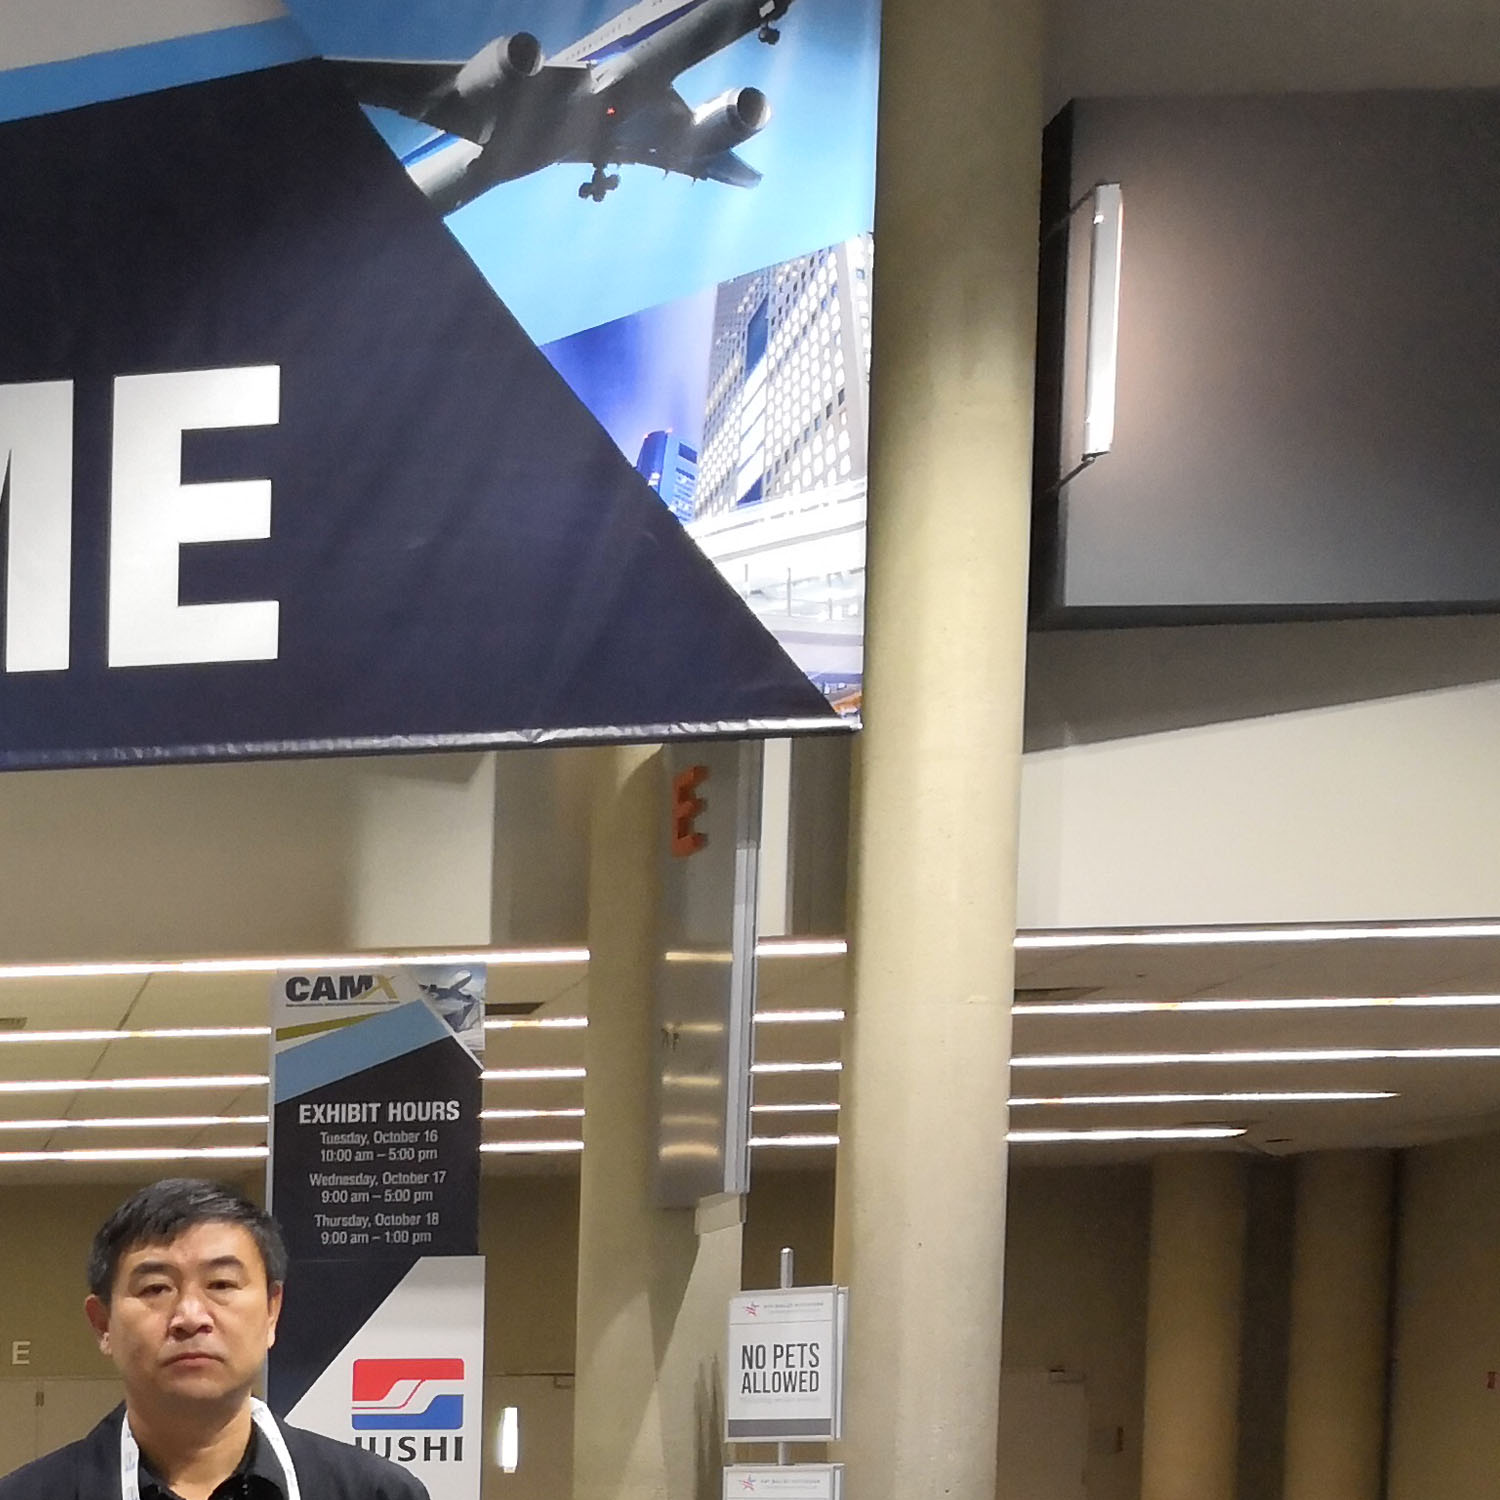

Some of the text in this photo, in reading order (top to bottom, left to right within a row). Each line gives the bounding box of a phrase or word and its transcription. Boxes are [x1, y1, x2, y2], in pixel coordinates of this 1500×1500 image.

[671, 765, 709, 858] E
[285, 974, 399, 1002] CAMX
[299, 1100, 461, 1125] EXHIBIT HOURS
[320, 1129, 439, 1147] Tuesday, October 16
[320, 1149, 352, 1162] 10:00
[354, 1151, 374, 1162] am
[388, 1147, 415, 1161] 5:00
[418, 1149, 438, 1163] pm
[309, 1170, 447, 1188] Wednesday, October 17
[321, 1190, 348, 1204] 9:00
[350, 1192, 370, 1203] am
[384, 1189, 411, 1203] 5:00
[413, 1190, 433, 1204] pm
[314, 1212, 440, 1229] Thursday, October 18
[321, 1231, 348, 1245] 9:00
[350, 1233, 369, 1244] am
[385, 1230, 409, 1244] 1:00
[412, 1231, 432, 1245] pm
[12, 1341, 31, 1365] E
[741, 1343, 820, 1370] NO PETS
[741, 1370, 819, 1394] ALLOWED
